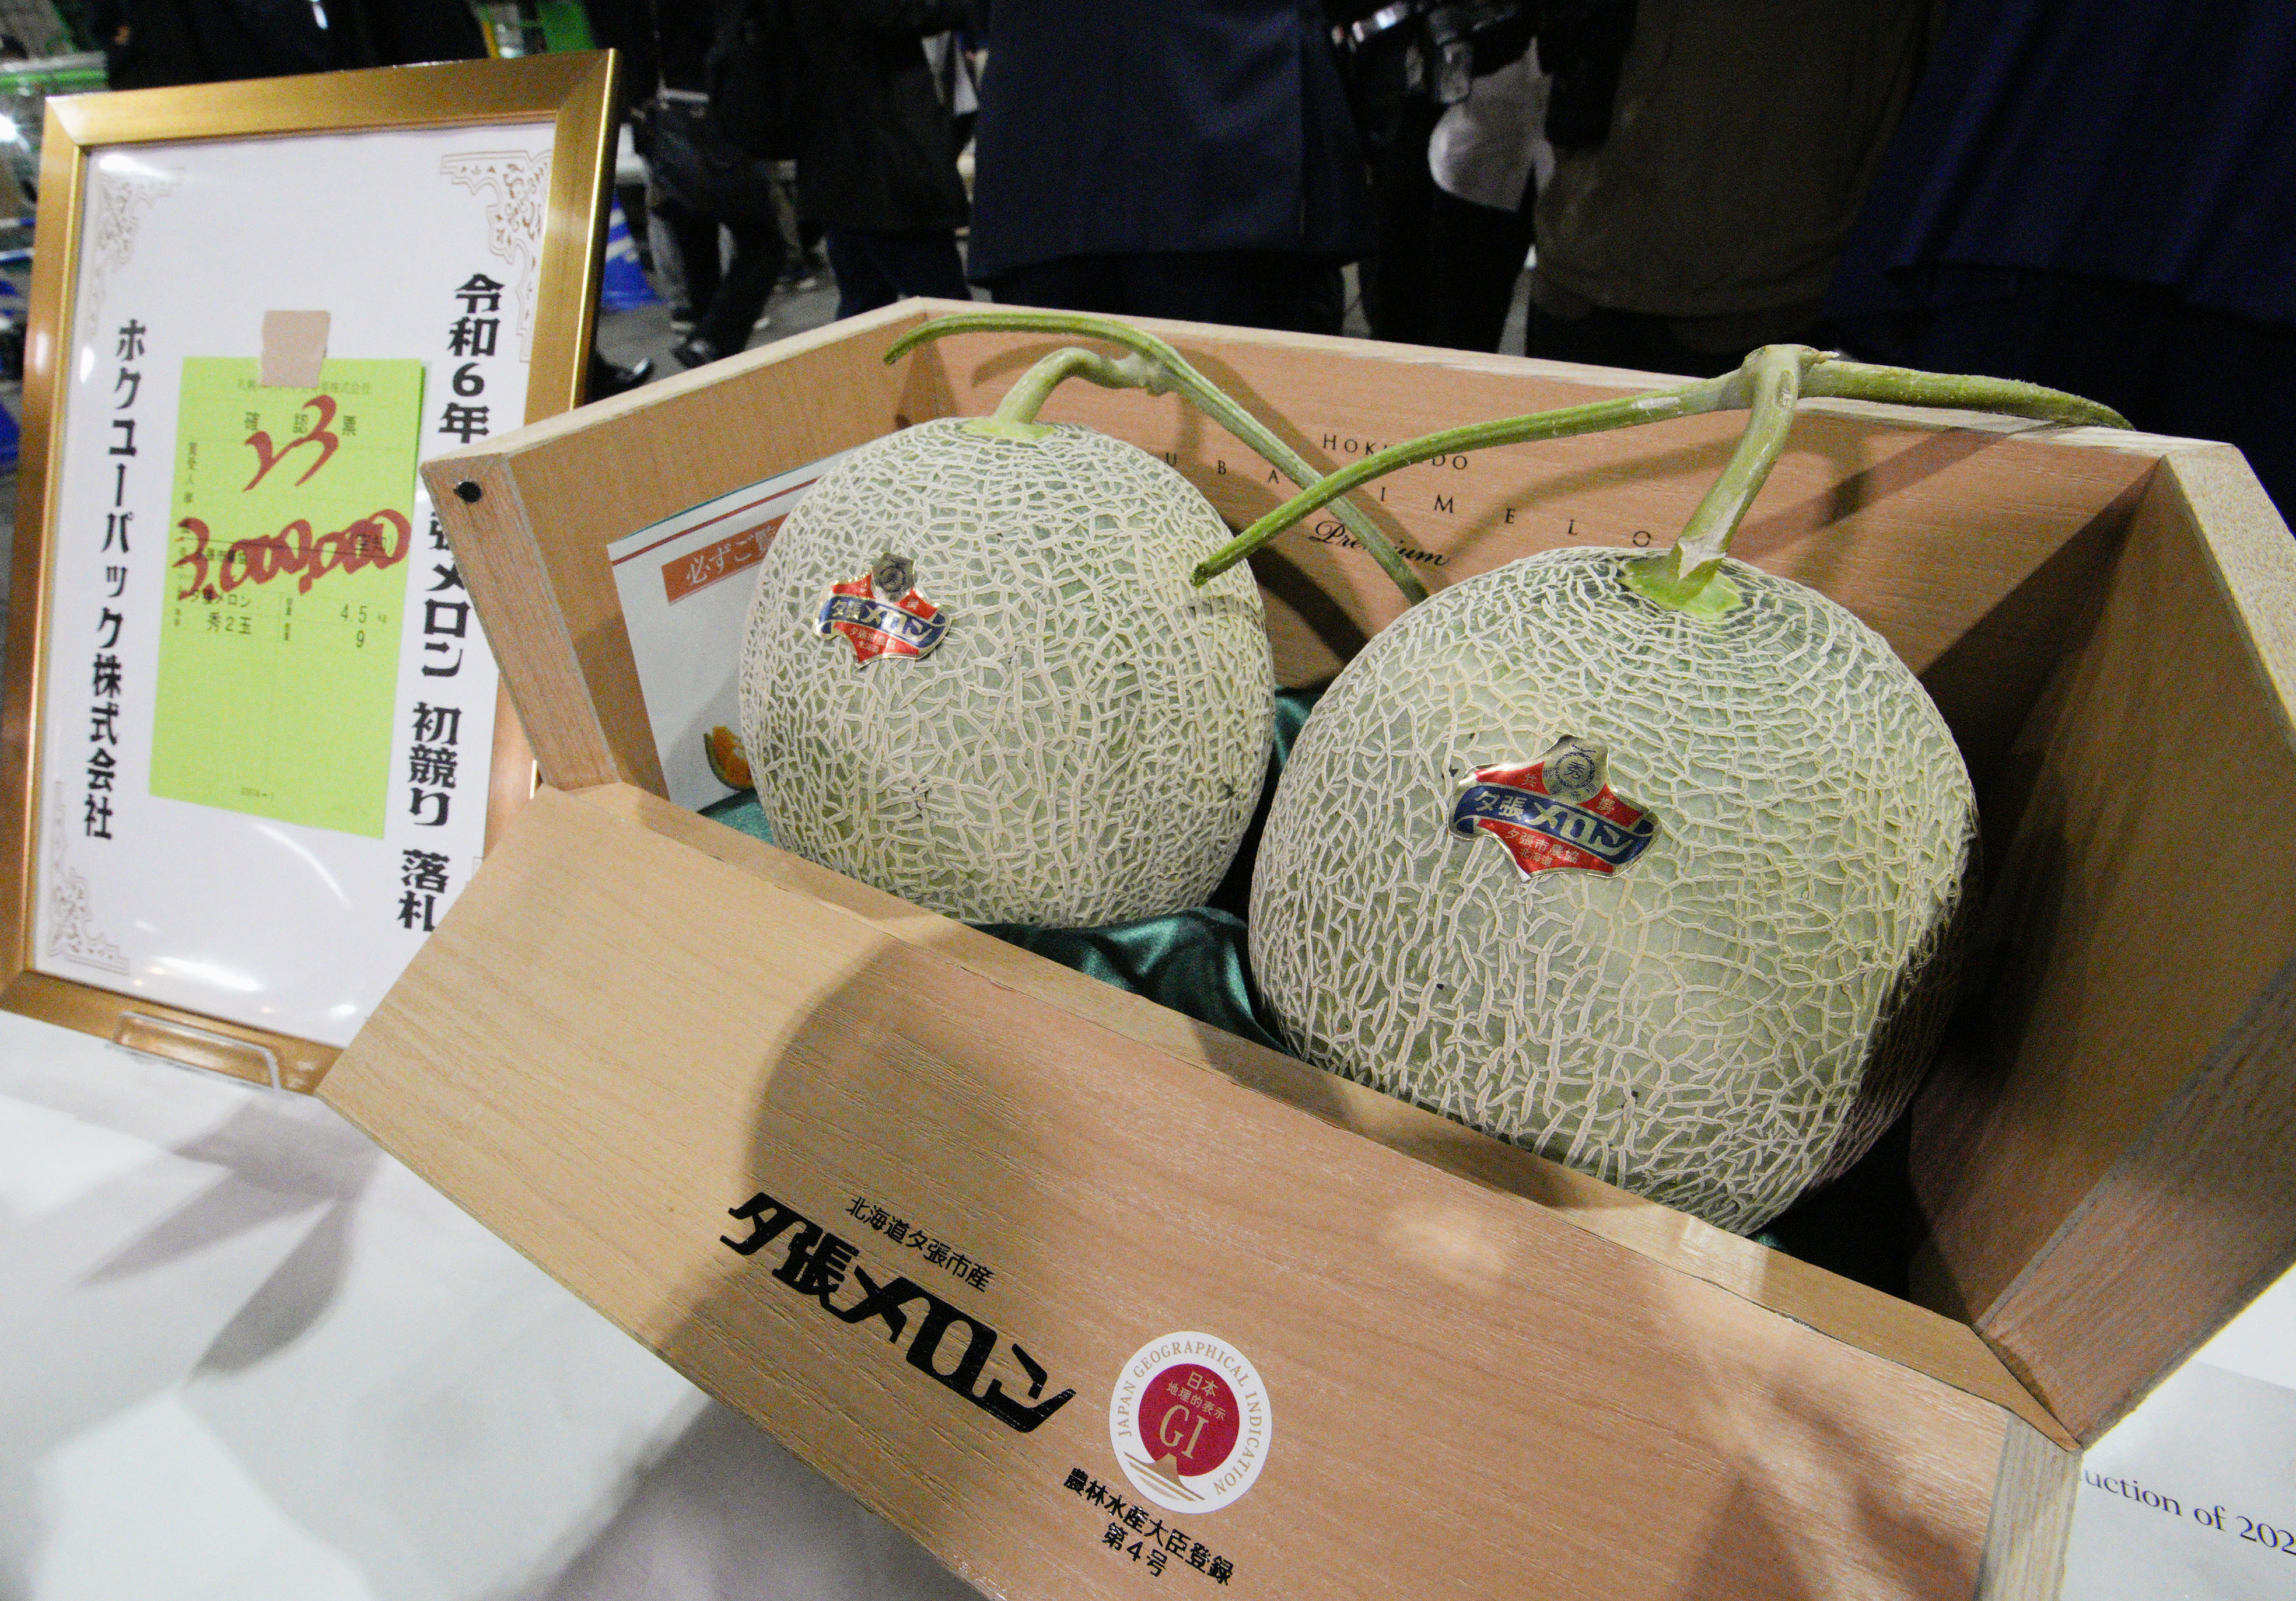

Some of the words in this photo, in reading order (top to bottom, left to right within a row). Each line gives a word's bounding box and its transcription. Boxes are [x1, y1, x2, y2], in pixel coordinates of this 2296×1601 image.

[438, 273, 505, 444] 令和6年
[1323, 434, 1468, 470] HOKDO
[1308, 520, 1450, 565] Preium
[1434, 494, 1651, 548] MELO
[85, 318, 146, 840] ホクユーパック株式会社
[356, 630, 365, 648] 9
[832, 600, 933, 641] 夕張メロン
[408, 701, 462, 826] 初競り
[1564, 761, 1586, 779] 秀
[1475, 791, 1633, 856] 夕張メロン
[1520, 847, 1553, 867] 北海道
[397, 849, 450, 932] 落札
[845, 1196, 995, 1292] 北海道夕張市産
[720, 1192, 1077, 1433] 夕張メロン
[1167, 1382, 1226, 1420] 地理的表示
[1186, 1371, 1219, 1397] 日本
[1118, 1379, 1137, 1437] JAPAN
[1134, 1340, 1250, 1387] GEOGRAPHICAL
[1213, 1390, 1262, 1496] INDICATION
[1160, 1404, 1209, 1459] GI
[1063, 1467, 1234, 1586] 農林水産大臣登録
[2081, 1469, 2182, 1516] uction
[2194, 1505, 2226, 1532] of
[2236, 1515, 2296, 1556] 202
